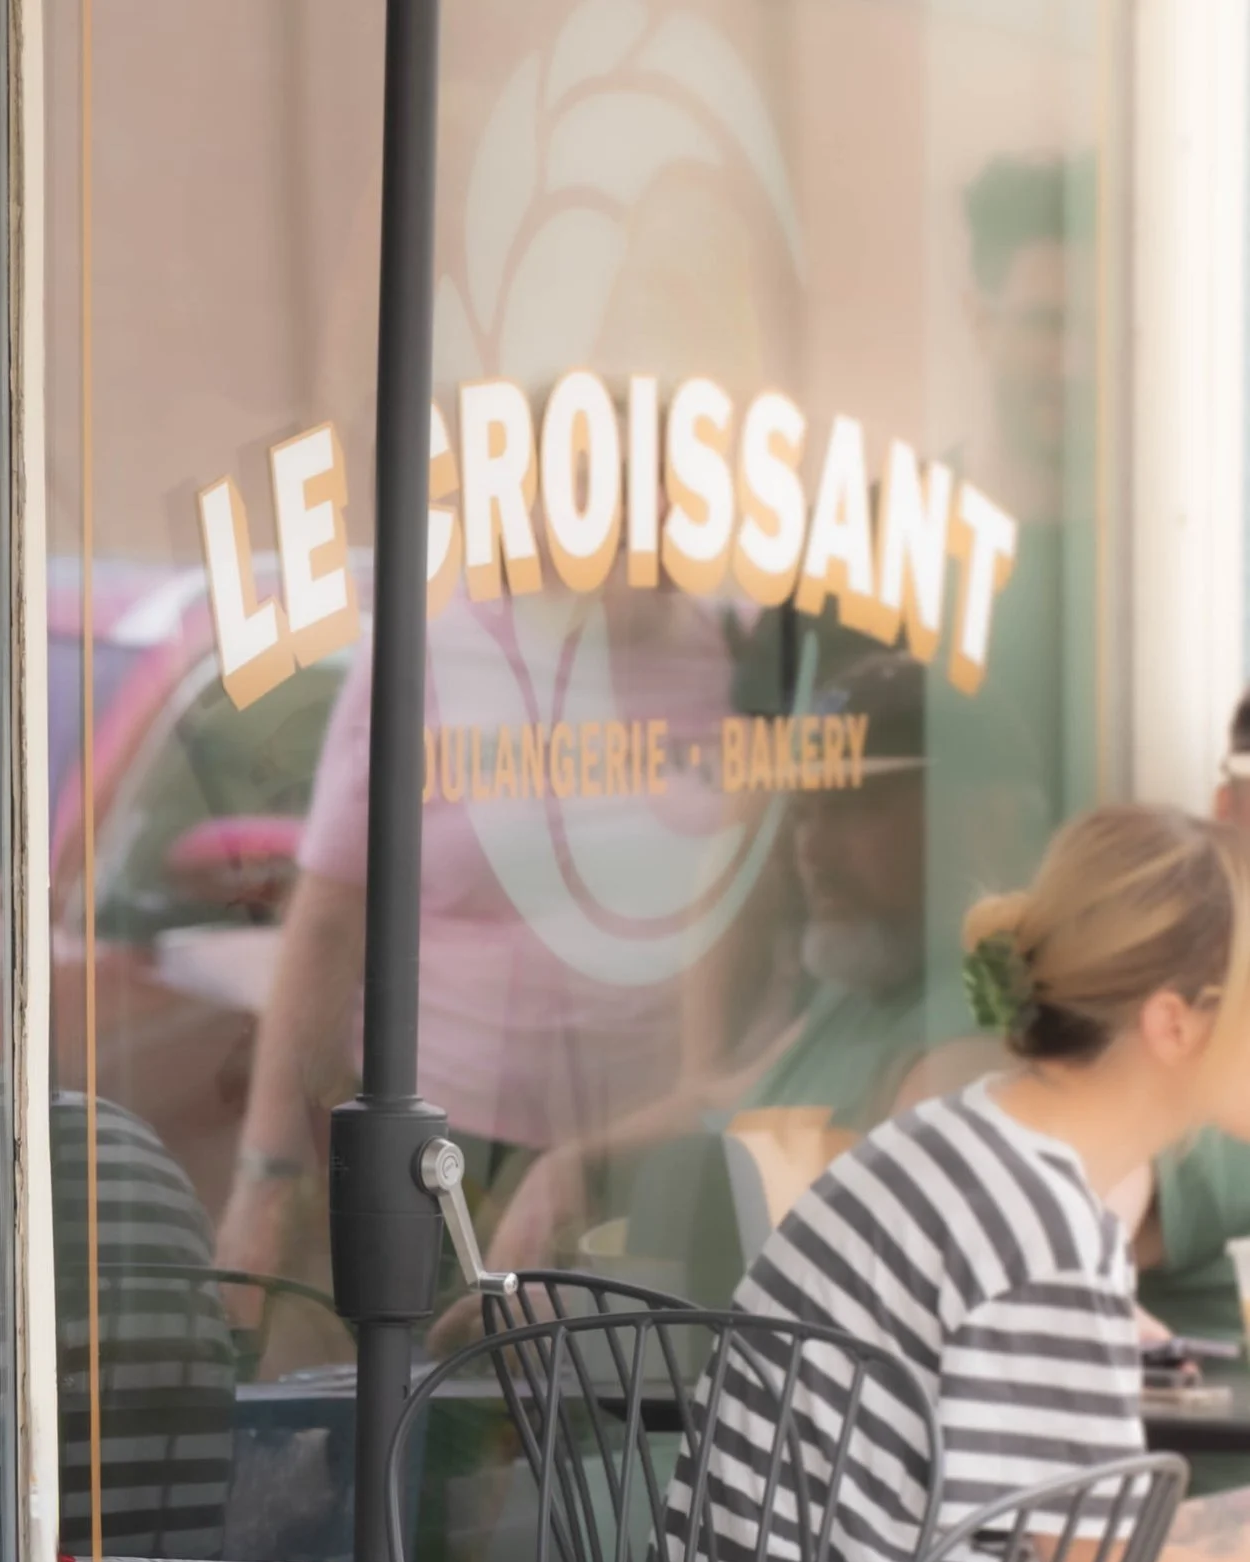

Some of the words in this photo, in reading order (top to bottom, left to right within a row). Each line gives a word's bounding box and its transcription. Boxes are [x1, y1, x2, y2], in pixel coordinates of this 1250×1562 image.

[197, 419, 358, 711] LE
[422, 719, 668, 805] ULANGERIE
[721, 714, 869, 794] BAKERY
